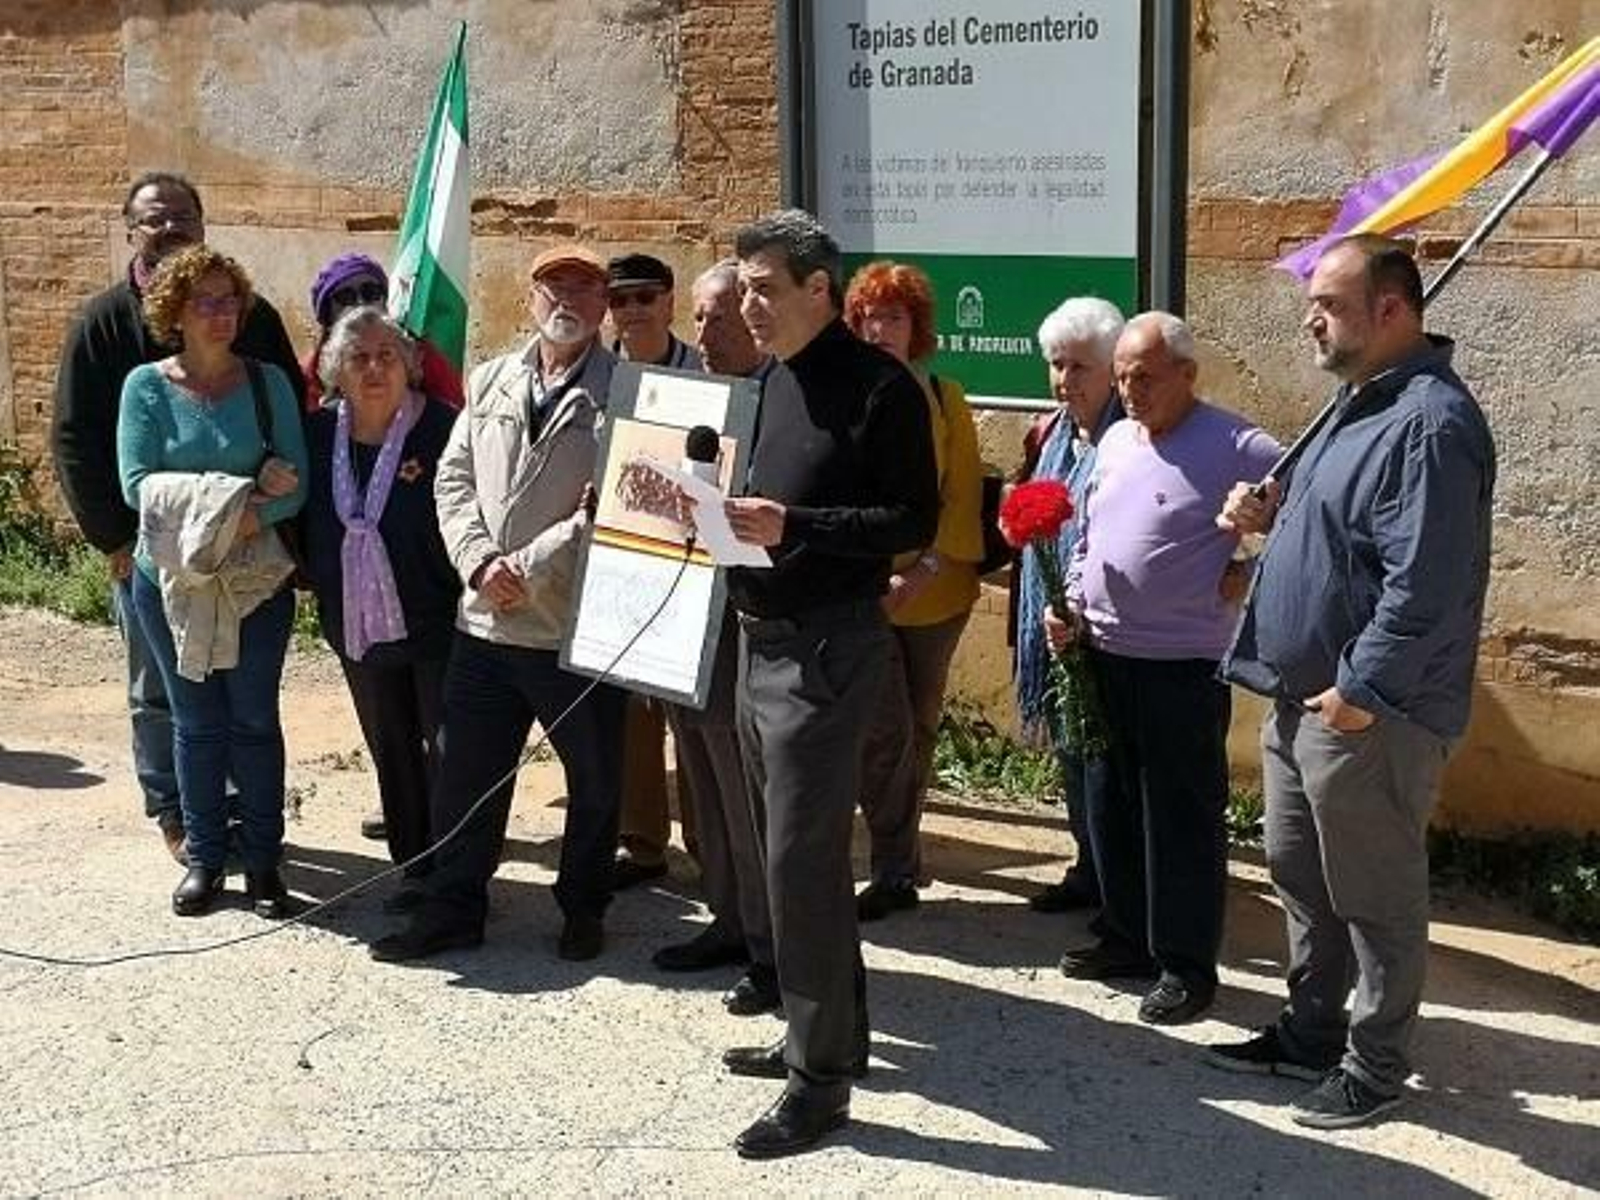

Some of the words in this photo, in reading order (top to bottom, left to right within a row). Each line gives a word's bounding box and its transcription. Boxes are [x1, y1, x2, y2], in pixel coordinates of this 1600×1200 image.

[847, 21, 917, 54] Tapias
[923, 19, 956, 46] del
[964, 11, 1099, 45] Cementerio
[849, 62, 874, 89] de
[881, 57, 974, 88] Granada
[949, 335, 965, 352] DE
